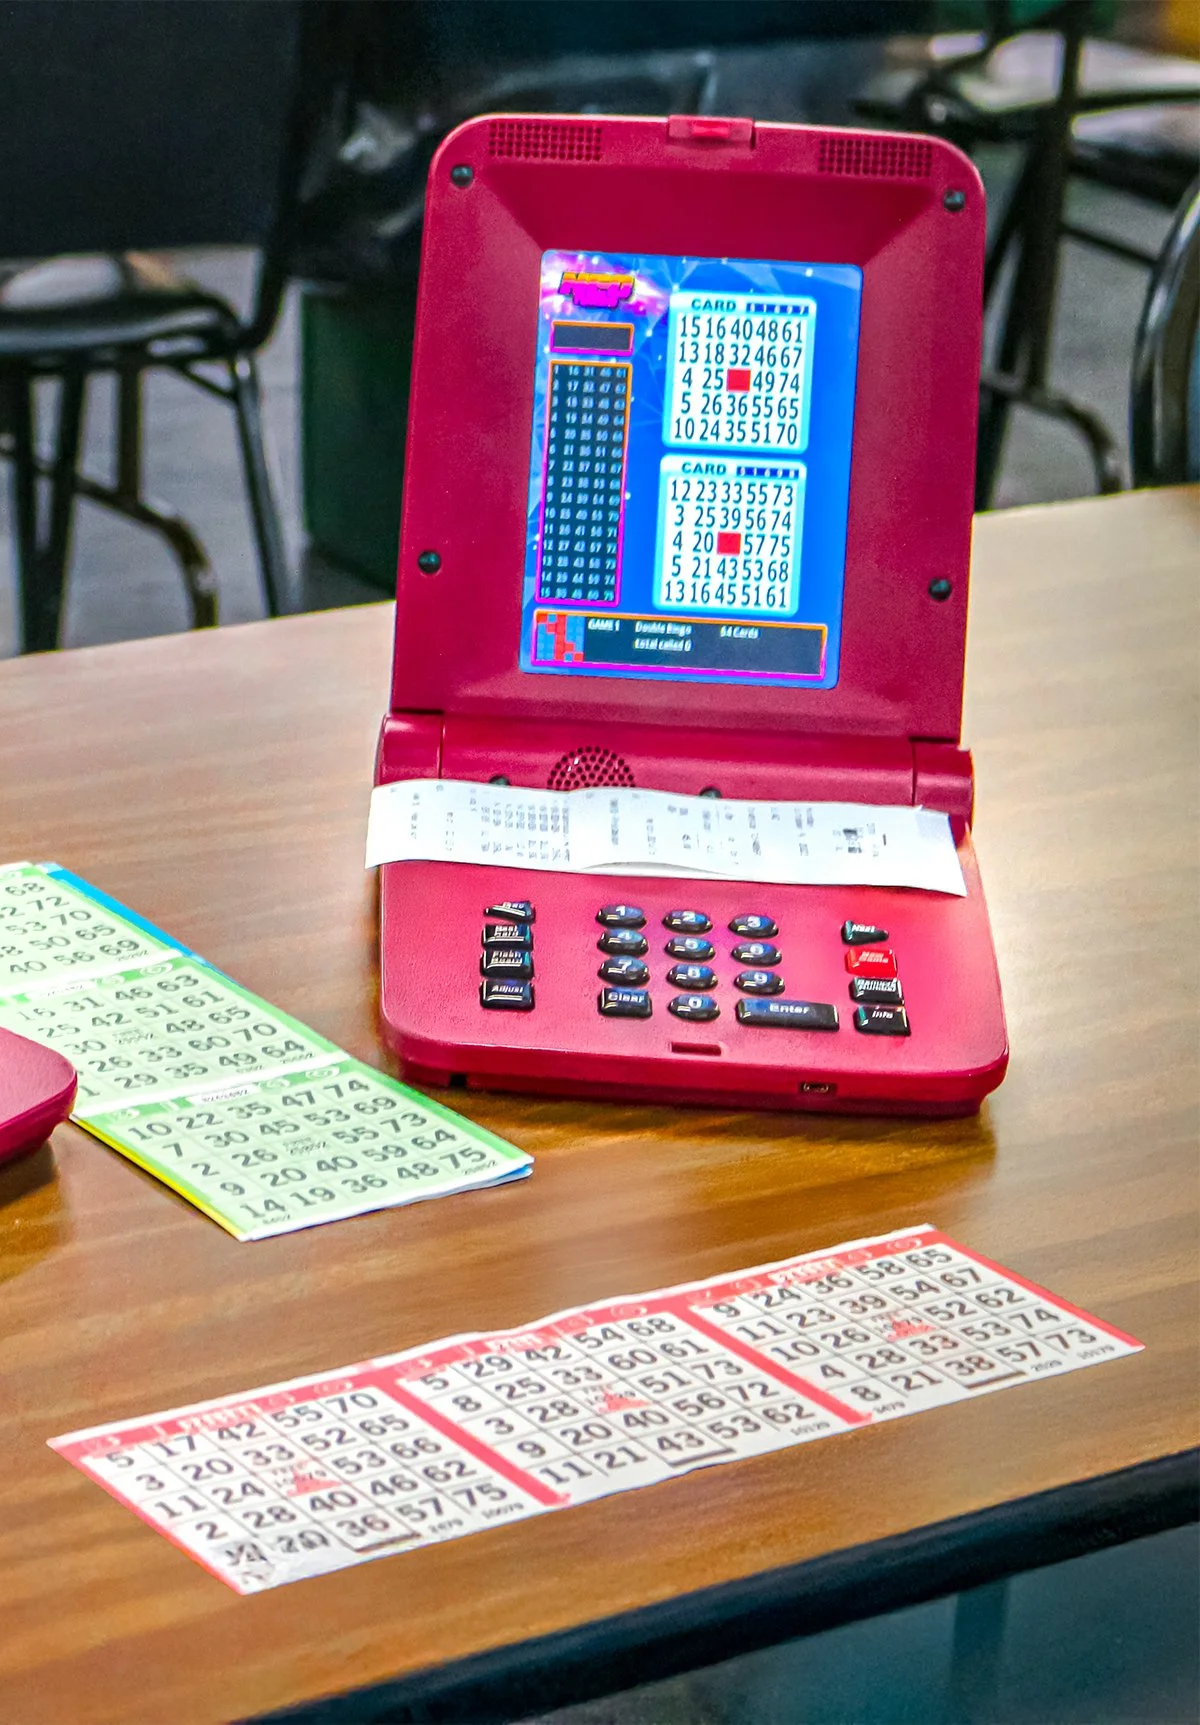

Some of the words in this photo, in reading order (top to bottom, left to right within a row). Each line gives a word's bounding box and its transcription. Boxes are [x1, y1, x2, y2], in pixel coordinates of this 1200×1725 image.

[681, 316, 700, 337] 15
[706, 317, 726, 339] 16
[731, 319, 752, 340] 40
[756, 320, 778, 342] 48
[782, 321, 802, 343] 61
[691, 299, 736, 312] CARD
[679, 342, 699, 363] 13
[704, 342, 724, 365] 18
[729, 344, 750, 366] 32
[754, 345, 777, 367] 46
[780, 347, 802, 368] 67
[671, 479, 690, 501] 12
[696, 481, 717, 502] 23
[721, 482, 742, 504] 33
[747, 483, 768, 505] 55
[773, 485, 793, 507] 73
[682, 462, 726, 475] CARD
[675, 505, 684, 526] 3
[694, 506, 715, 528] 25
[720, 508, 741, 529] 39
[745, 509, 766, 531] 56
[771, 511, 791, 531] 74
[37, 1023, 80, 1038] 25
[91, 1012, 132, 1028] 42
[136, 1003, 179, 1018] 51
[182, 990, 225, 1008] 61
[769, 1004, 810, 1014] Enter
[128, 1122, 172, 1141] 10
[177, 1112, 224, 1130] 22
[227, 1102, 273, 1120] 35
[280, 1091, 317, 1107] 47
[323, 1080, 370, 1098] 74
[163, 1143, 183, 1159] 7
[204, 1129, 250, 1148] 30
[259, 1119, 301, 1137] 45
[304, 1107, 351, 1126] 53
[354, 1097, 398, 1115] 69
[220, 1181, 246, 1196] 9
[259, 1168, 307, 1187] 20
[316, 1155, 358, 1173] 40
[362, 1144, 408, 1163] 59
[410, 1129, 458, 1150] 64
[240, 1199, 286, 1218] 14
[290, 1187, 336, 1206] 19
[341, 1173, 387, 1194] 36
[397, 1162, 439, 1181] 48
[439, 1147, 487, 1170] 75
[712, 1301, 741, 1319] 9
[752, 1287, 802, 1308] 24
[806, 1274, 854, 1296] 36
[857, 1260, 906, 1281] 58
[906, 1249, 952, 1269] 65
[420, 1371, 449, 1390] 5
[463, 1355, 513, 1378] 29
[525, 1345, 572, 1365] 42
[574, 1326, 624, 1348] 54
[628, 1318, 676, 1337] 68
[451, 1395, 481, 1412] 8
[495, 1378, 546, 1399] 25
[552, 1365, 602, 1386] 33
[608, 1348, 658, 1371] 60
[660, 1339, 709, 1359] 61
[819, 1363, 847, 1382] 4
[855, 1349, 906, 1370] 28
[908, 1334, 959, 1355] 33
[960, 1320, 1011, 1342] 53
[1008, 1308, 1060, 1330] 74
[850, 1385, 881, 1403] 8
[890, 1370, 943, 1392] 21
[944, 1355, 995, 1376] 38
[998, 1342, 1042, 1364] 57
[1044, 1329, 1097, 1349] 73
[105, 1450, 136, 1469] 5
[152, 1434, 198, 1459] 17
[215, 1422, 266, 1442] 42
[272, 1406, 324, 1428] 55
[333, 1392, 379, 1415] 70
[135, 1472, 165, 1492] 3
[180, 1459, 234, 1481] 20
[242, 1443, 296, 1467] 33
[300, 1428, 357, 1451] 52
[358, 1413, 410, 1437] 65
[517, 1440, 546, 1459] 9
[559, 1424, 613, 1446] 20
[622, 1409, 670, 1430] 40
[673, 1393, 725, 1417] 56
[725, 1382, 780, 1403] 72
[195, 1520, 228, 1540] 2
[241, 1504, 297, 1528] 28
[307, 1489, 358, 1512] 40
[367, 1472, 419, 1497] 46
[422, 1458, 477, 1483] 62
